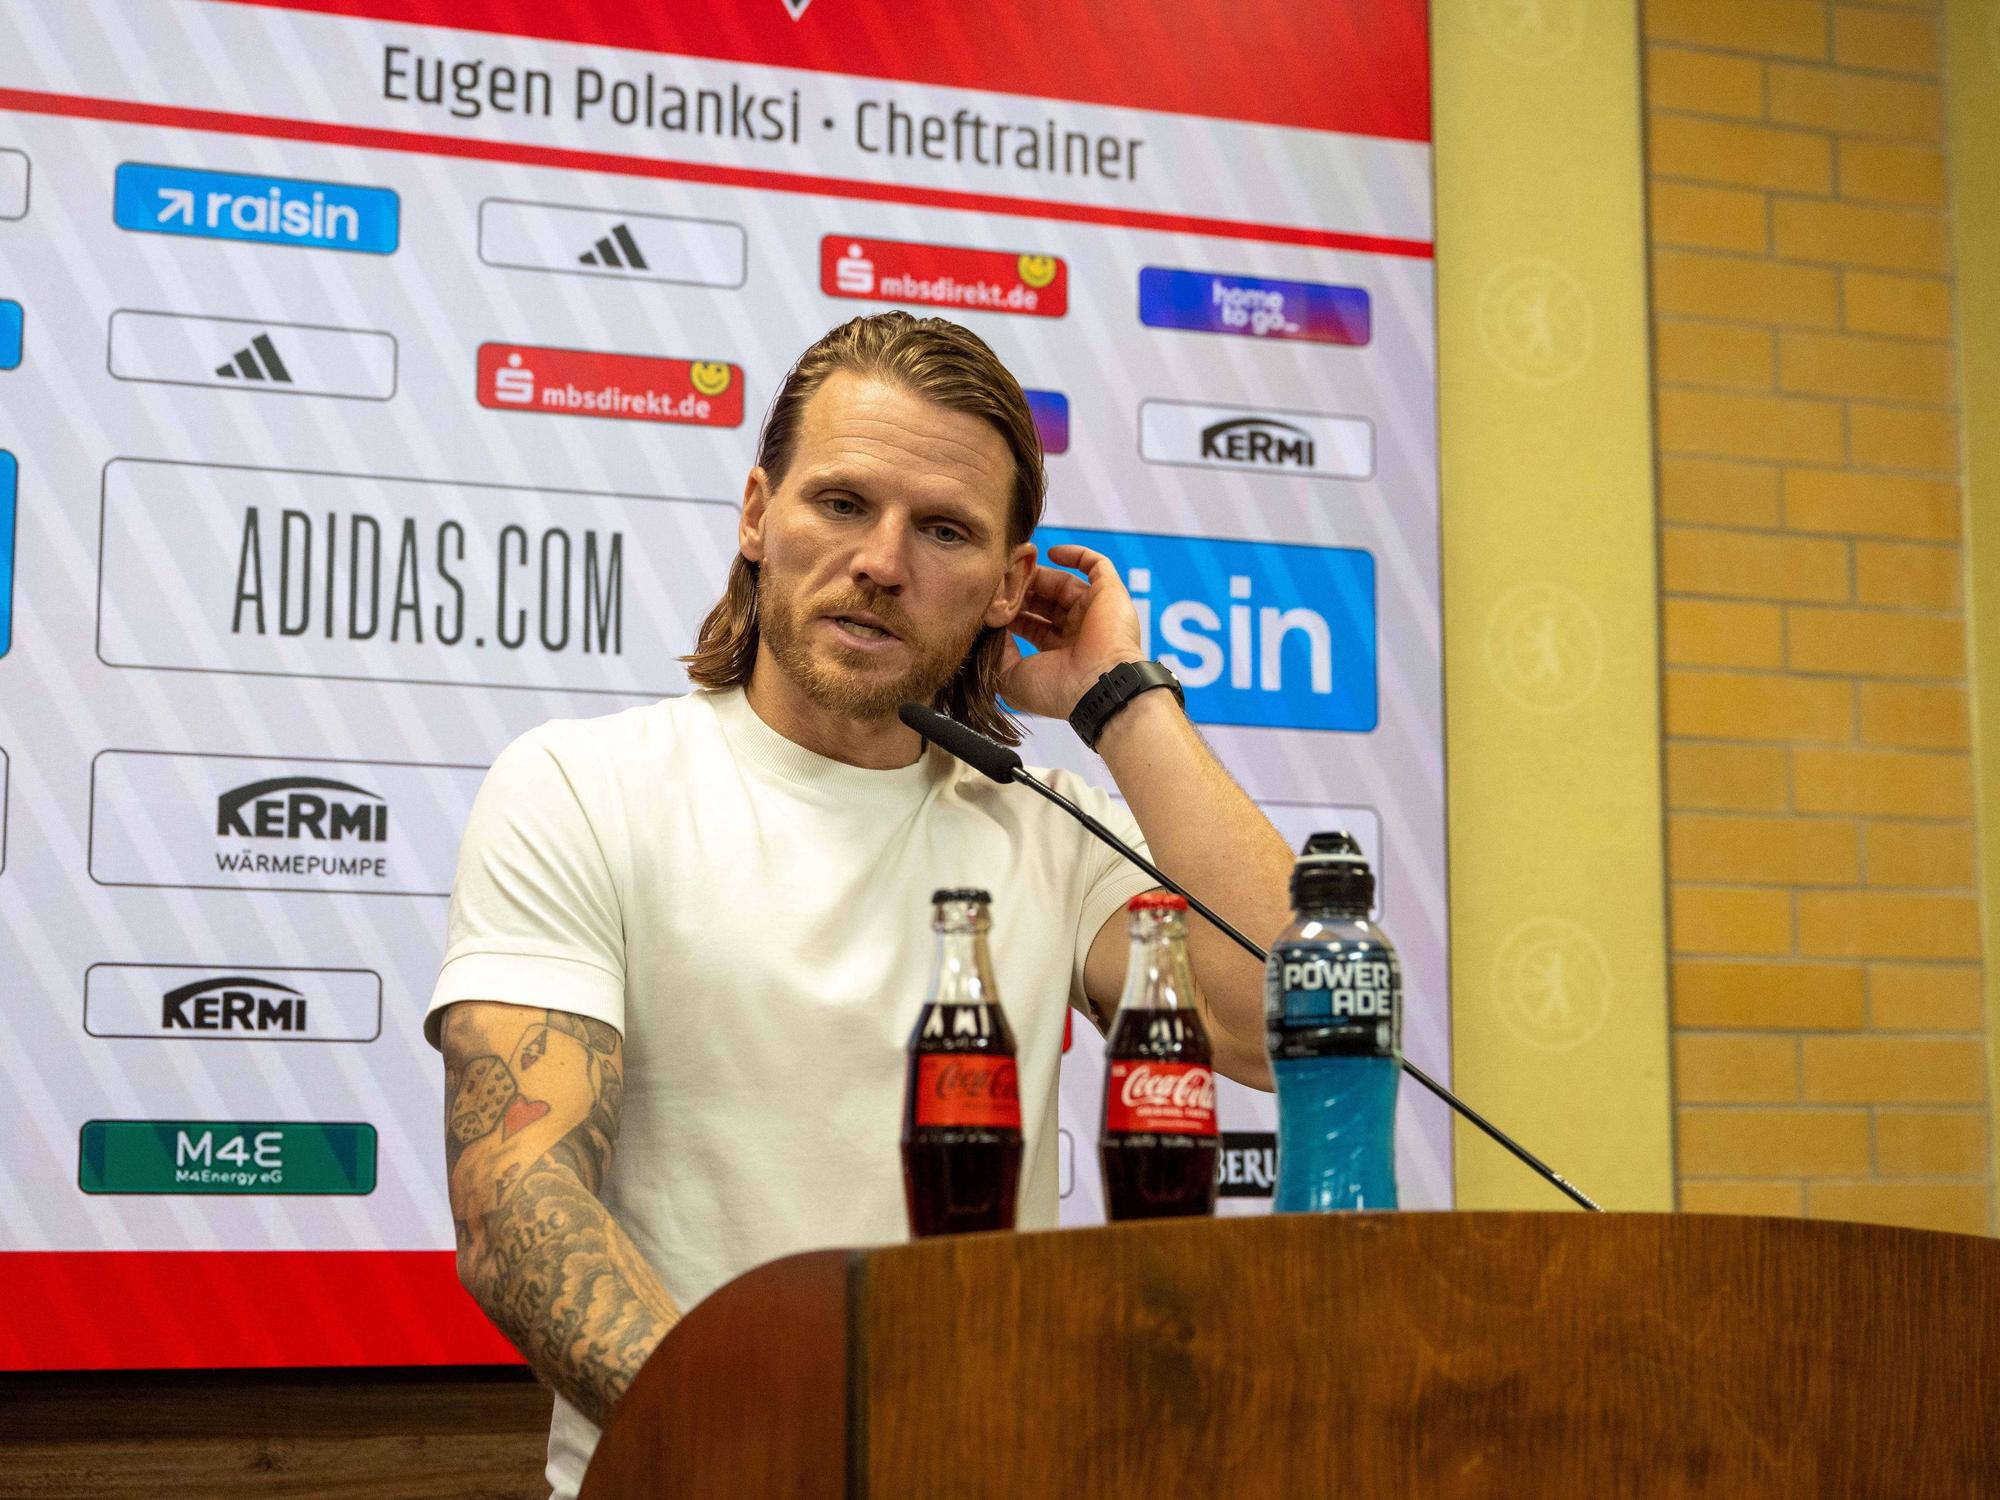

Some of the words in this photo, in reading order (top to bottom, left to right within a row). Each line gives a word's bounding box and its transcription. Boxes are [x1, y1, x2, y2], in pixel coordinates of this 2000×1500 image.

[383, 46, 551, 118] Eugen
[576, 72, 801, 143] Polanksi
[856, 102, 1144, 182] Cheftrainer
[206, 188, 358, 242] raisin
[880, 274, 1038, 312] mbsdirekt.de
[1212, 279, 1284, 312] home
[1222, 304, 1250, 326] to
[542, 384, 711, 420] mbsdirekt.de
[1201, 418, 1314, 467] KERMI
[232, 507, 623, 655] ADIDAS.COM
[1128, 568, 1333, 695] isin
[217, 776, 388, 842] KERMI
[216, 848, 387, 878] WÄRMEPUMPE
[1283, 960, 1392, 992] POWER
[162, 977, 306, 1032] KERMI
[1331, 987, 1392, 1017] ADE
[176, 1130, 284, 1168] M4E
[175, 1169, 257, 1187] M4Energy
[260, 1170, 284, 1184] eG
